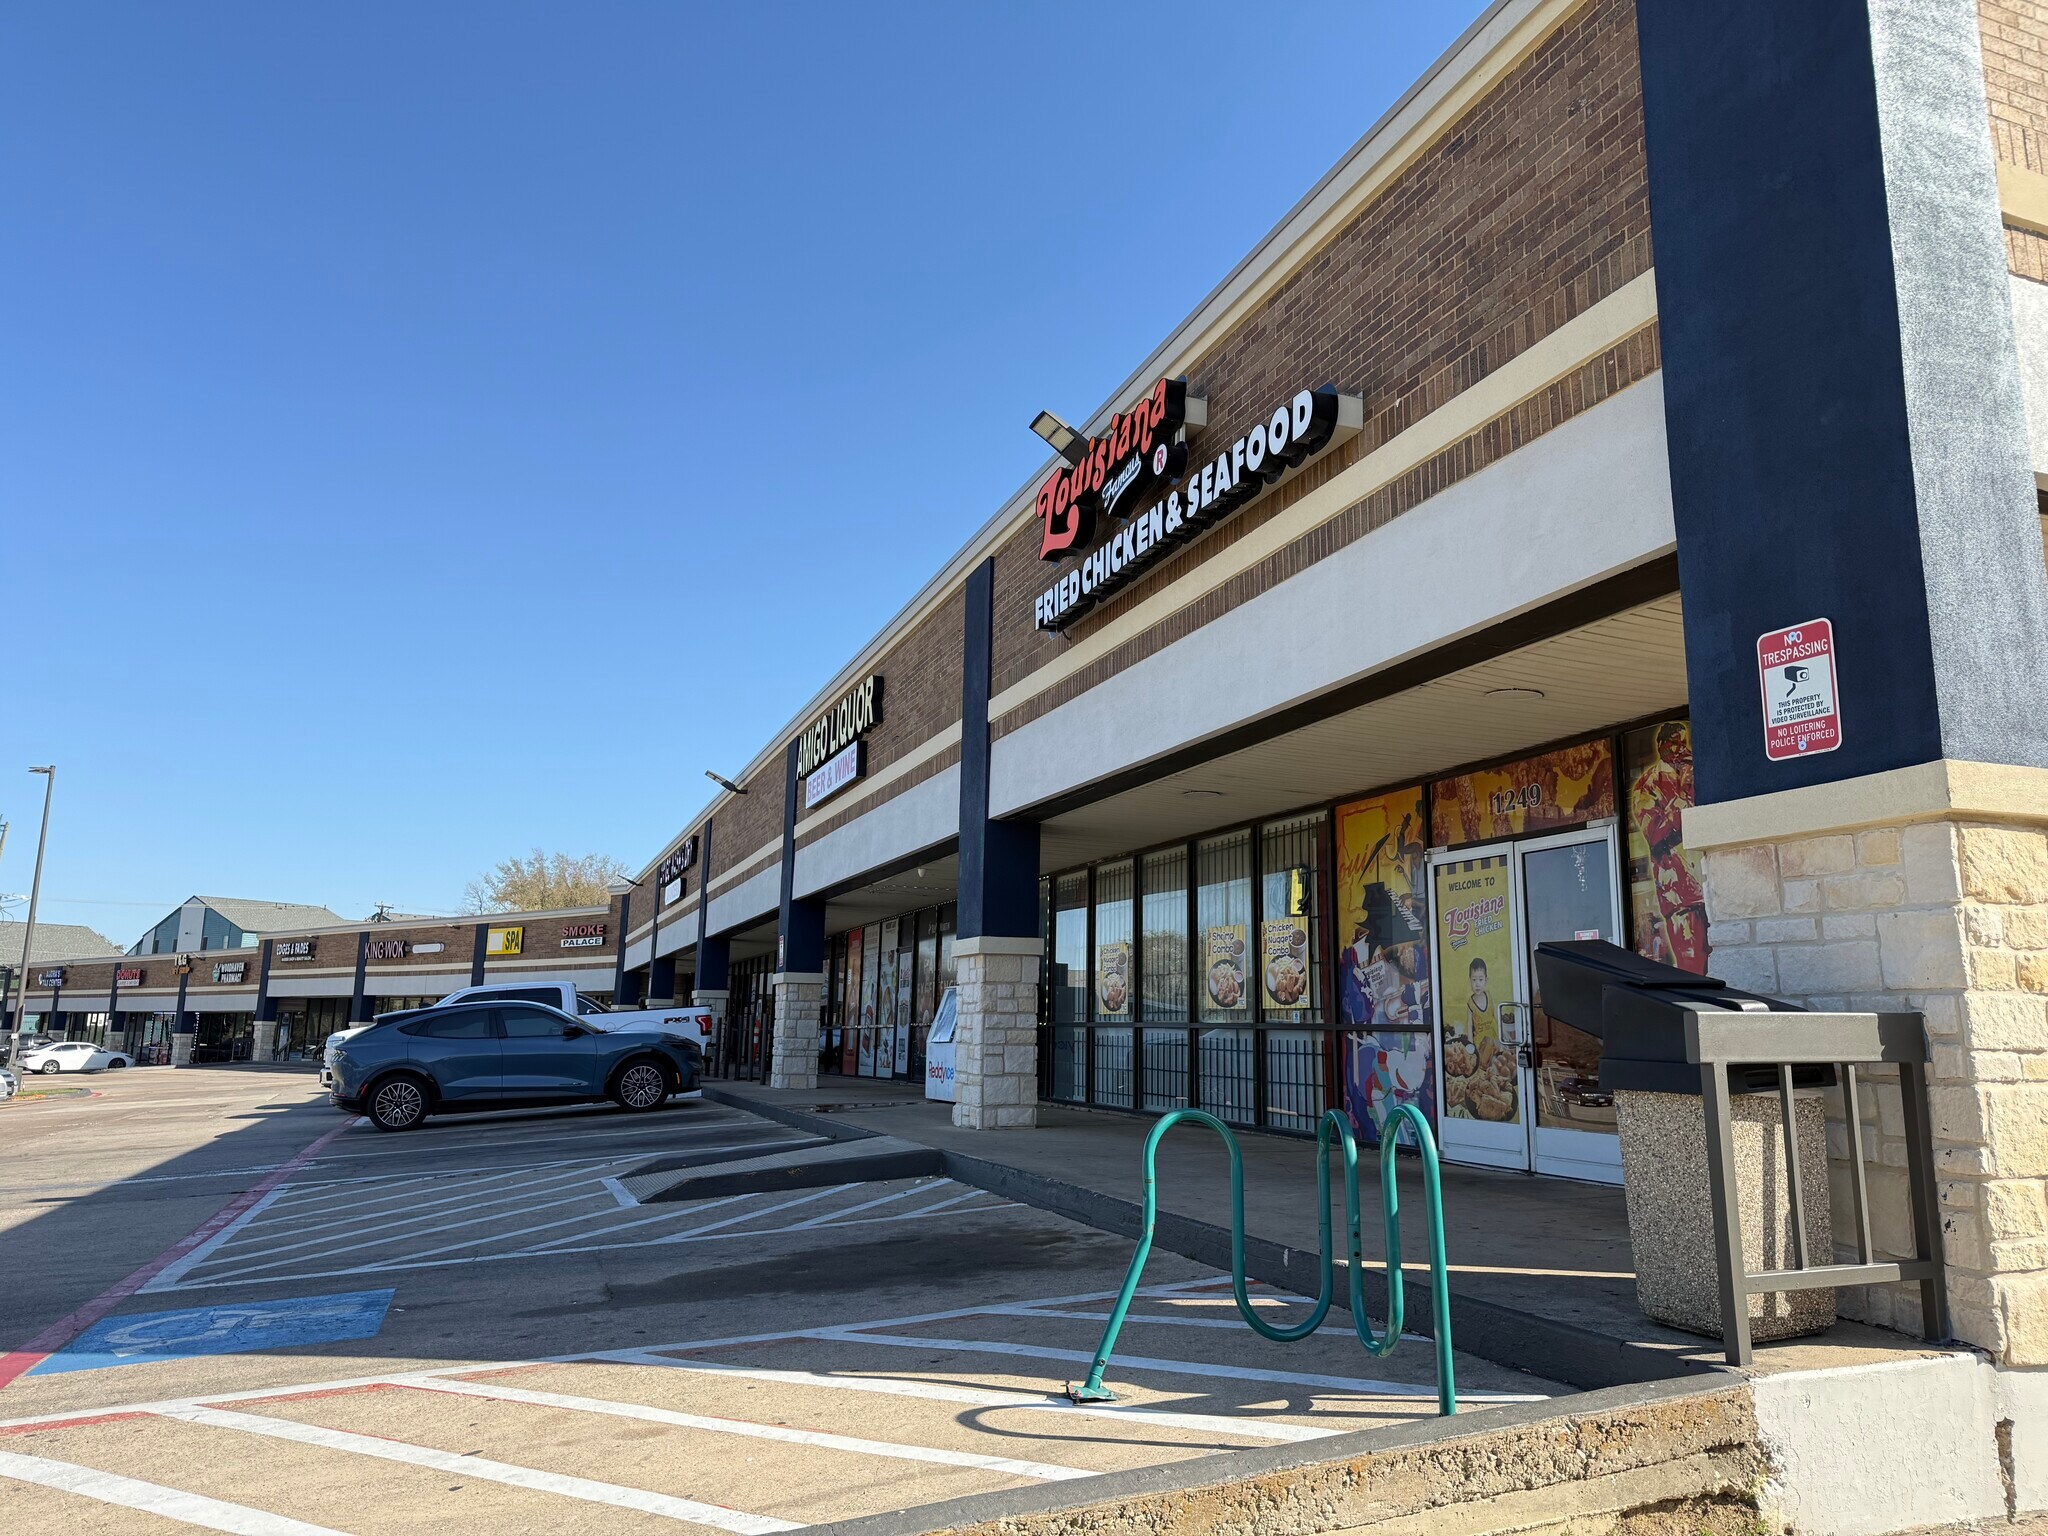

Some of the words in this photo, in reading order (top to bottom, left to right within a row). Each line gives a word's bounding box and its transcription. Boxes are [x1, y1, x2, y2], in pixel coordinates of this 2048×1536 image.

[1036, 378, 1167, 560] Louisiana
[1034, 568, 1080, 631] FRIED
[1082, 506, 1164, 594] CHICKEN
[1165, 490, 1182, 534] &
[1186, 389, 1313, 518] SEAFOOD
[1784, 631, 1802, 646] NO
[1763, 639, 1828, 665] TRESPASSING
[1778, 700, 1791, 708] THIS
[1791, 693, 1820, 705] PROPERTY
[1784, 702, 1815, 715] PROTECTED
[1815, 700, 1824, 708] BY
[1771, 715, 1788, 724] VIDEO
[1789, 706, 1831, 721] SURVEILLANCE
[796, 715, 828, 780] AMIGO
[830, 675, 874, 755] LIQUOR
[1777, 728, 1788, 737] NO
[1790, 720, 1826, 735] LOITERING
[1770, 736, 1795, 748] POLICE
[1797, 728, 1835, 743] ENFORCED
[807, 771, 825, 803] BEER
[827, 766, 833, 788] &
[834, 748, 856, 784] WINE
[1493, 783, 1542, 815] 1249
[1449, 878, 1482, 891] WELCOME
[1484, 877, 1496, 887] TO
[1444, 894, 1504, 938] Louisiana
[1475, 915, 1493, 928] FRIED
[562, 924, 604, 937] SMOKE
[1475, 920, 1503, 937] CHICKEN
[505, 931, 520, 951] SPA
[563, 937, 601, 946] PALACE
[663, 1016, 690, 1025] FX4
